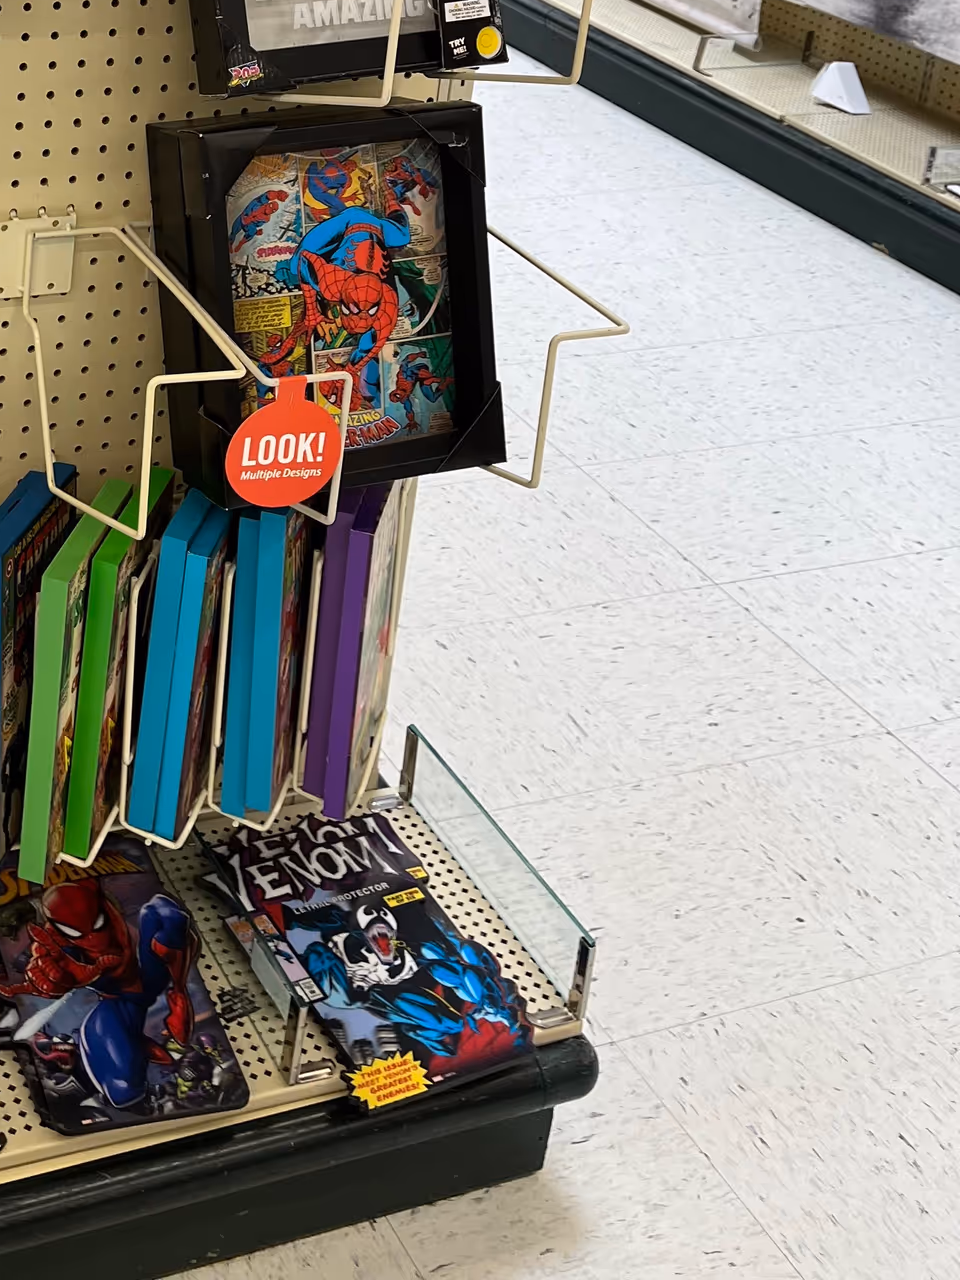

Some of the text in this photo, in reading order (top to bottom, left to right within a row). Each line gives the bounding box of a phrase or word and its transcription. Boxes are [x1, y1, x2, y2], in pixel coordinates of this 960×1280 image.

[448, 36, 466, 48] TRY
[453, 45, 468, 56] ME!
[240, 432, 327, 467] LOOK!
[240, 467, 321, 482] Multiple Designs
[202, 835, 400, 912] VENOM
[293, 881, 391, 916] LETHAL PROTECTOR
[357, 1078, 380, 1090] MEET
[383, 1064, 419, 1081] VENOM'S
[360, 1068, 382, 1080] THIS
[369, 1074, 413, 1095] GREATEST
[376, 1082, 420, 1102] ENEMIES!
